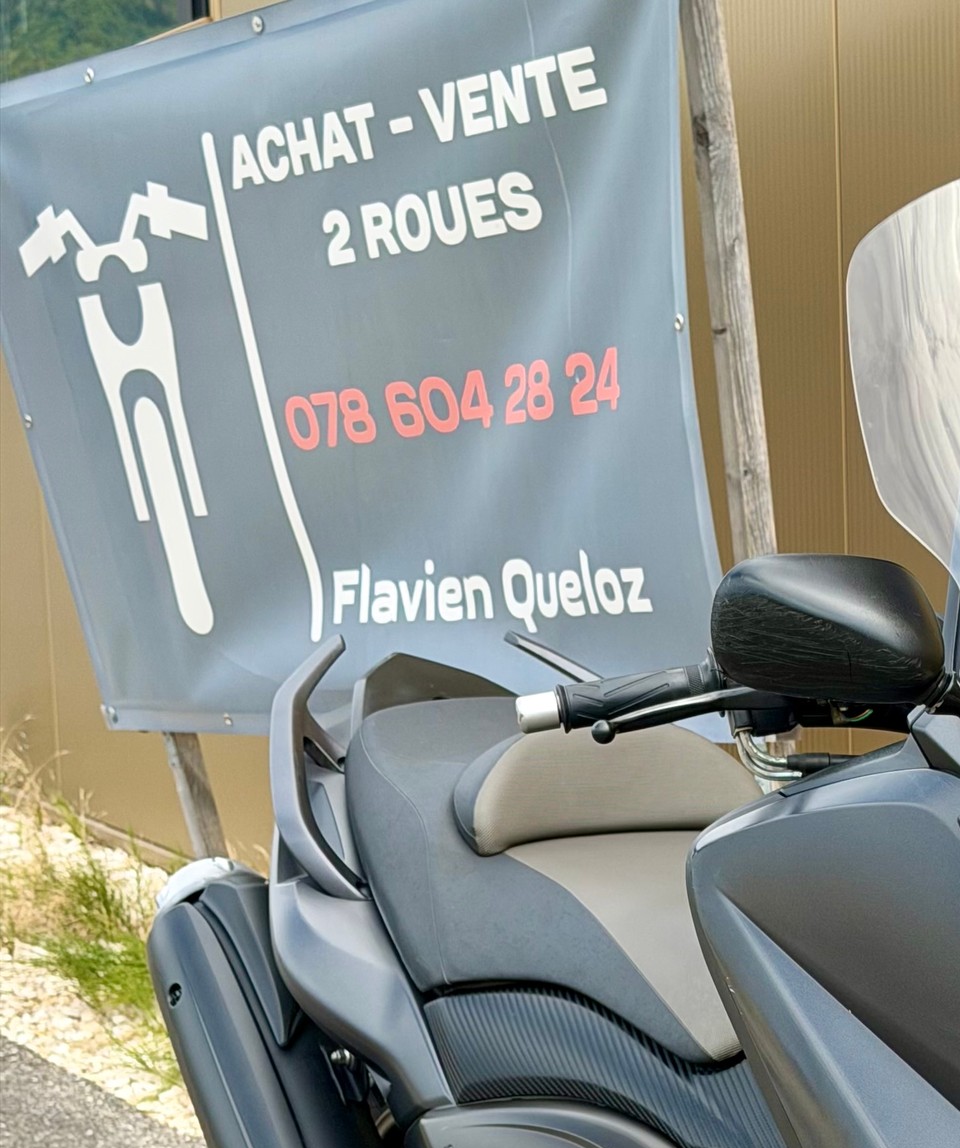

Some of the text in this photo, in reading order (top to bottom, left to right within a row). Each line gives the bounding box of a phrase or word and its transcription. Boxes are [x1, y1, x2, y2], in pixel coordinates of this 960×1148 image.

[232, 46, 608, 190] ACHAT - VENTE
[322, 171, 543, 267] 2 ROUES
[285, 347, 620, 451] 078 604 28 24
[332, 549, 653, 634] Flavien Queloz
